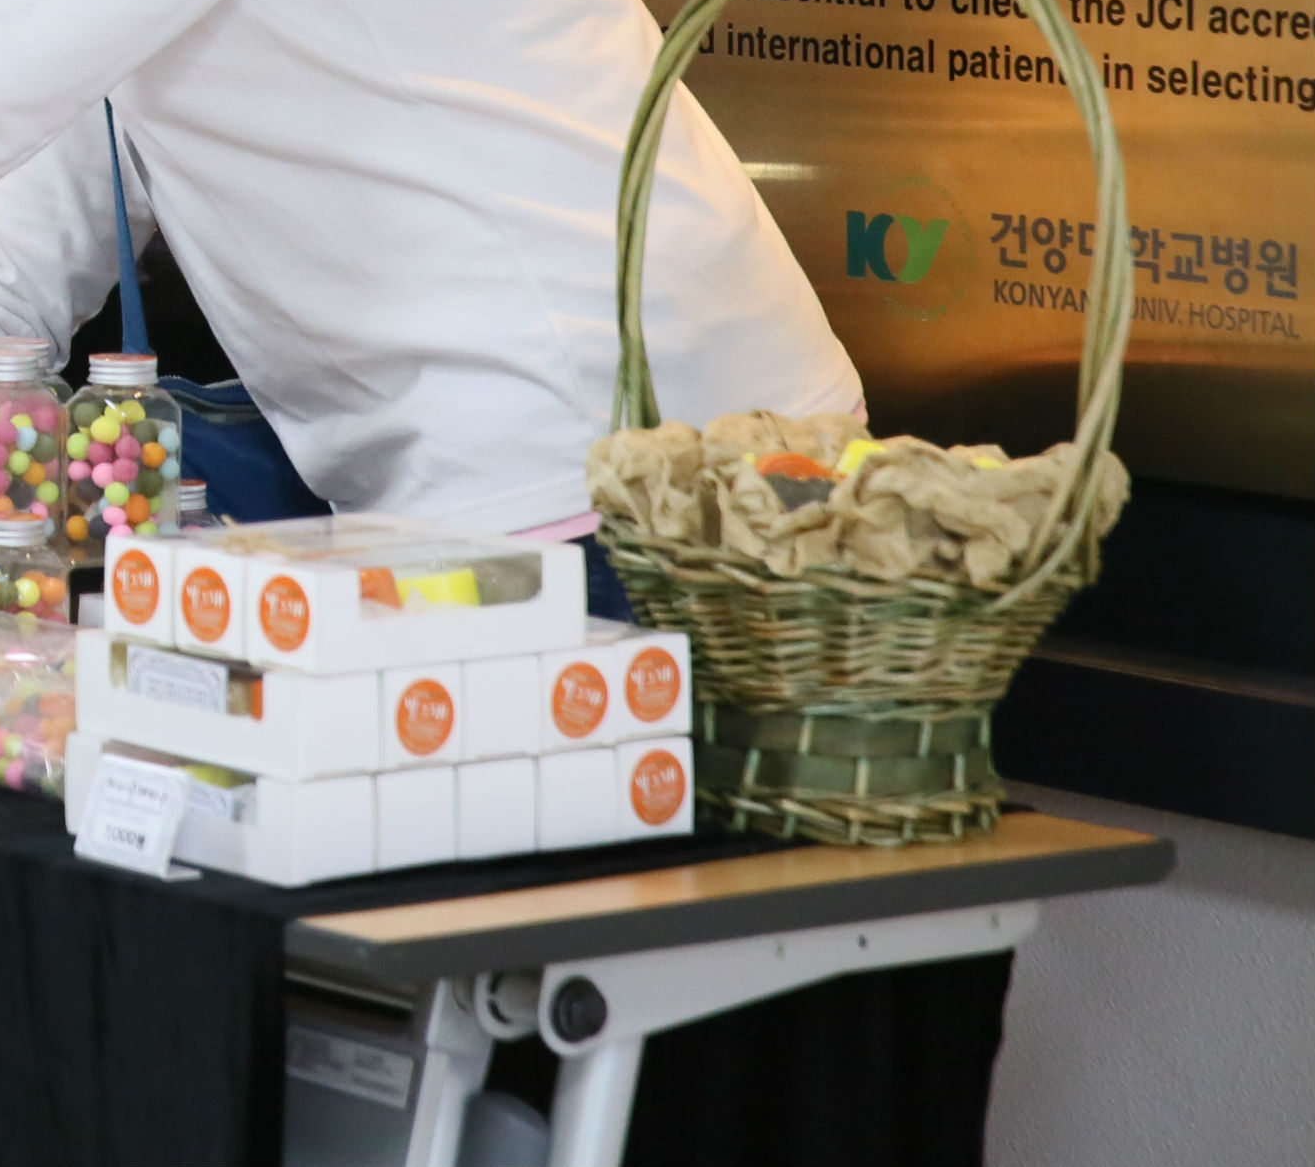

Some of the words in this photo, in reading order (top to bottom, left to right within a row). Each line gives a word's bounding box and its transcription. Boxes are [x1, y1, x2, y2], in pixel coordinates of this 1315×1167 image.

[1209, 5, 1315, 41] accre
[728, 22, 935, 73] international
[949, 45, 1068, 86] patien
[1102, 53, 1134, 91] in
[1147, 60, 1315, 112] selecting
[1188, 302, 1301, 339] HOSPITAL
